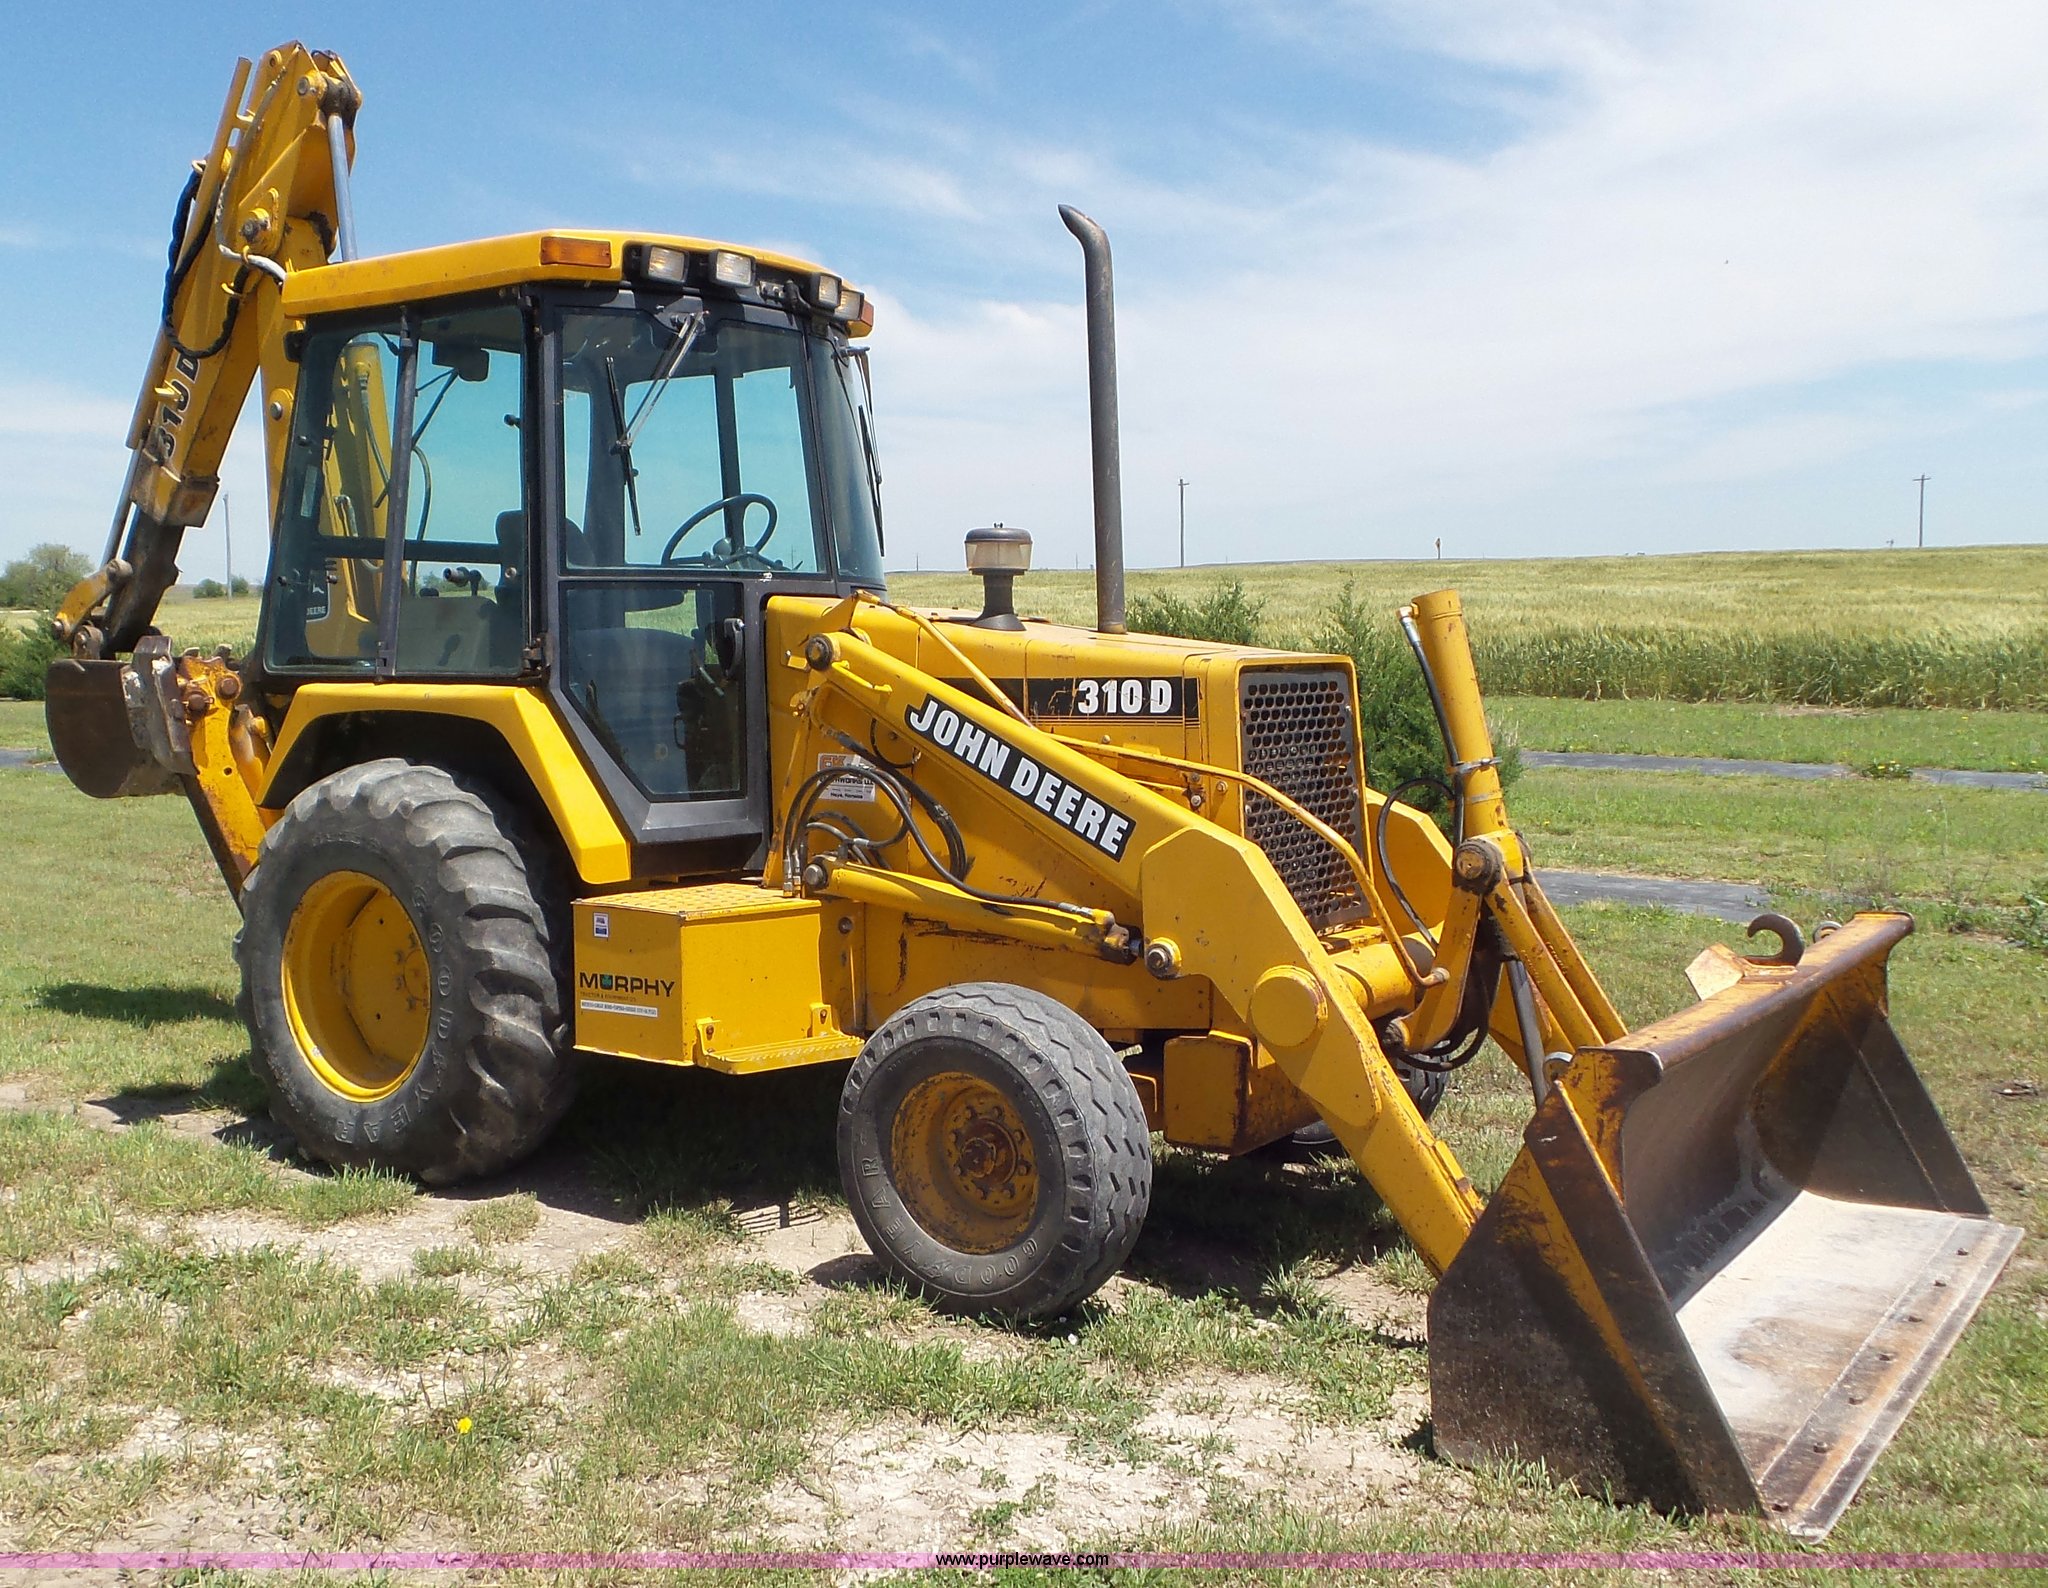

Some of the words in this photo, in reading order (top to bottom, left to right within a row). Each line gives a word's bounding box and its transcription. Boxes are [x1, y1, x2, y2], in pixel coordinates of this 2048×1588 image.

[156, 378, 191, 460] 310
[1077, 679, 1144, 715] 310
[1150, 679, 1173, 715] D
[909, 699, 1011, 780] JOHN
[1010, 757, 1129, 855] DEERE
[579, 971, 675, 997] MURPHY
[861, 1156, 1039, 1286] GOODYEAR
